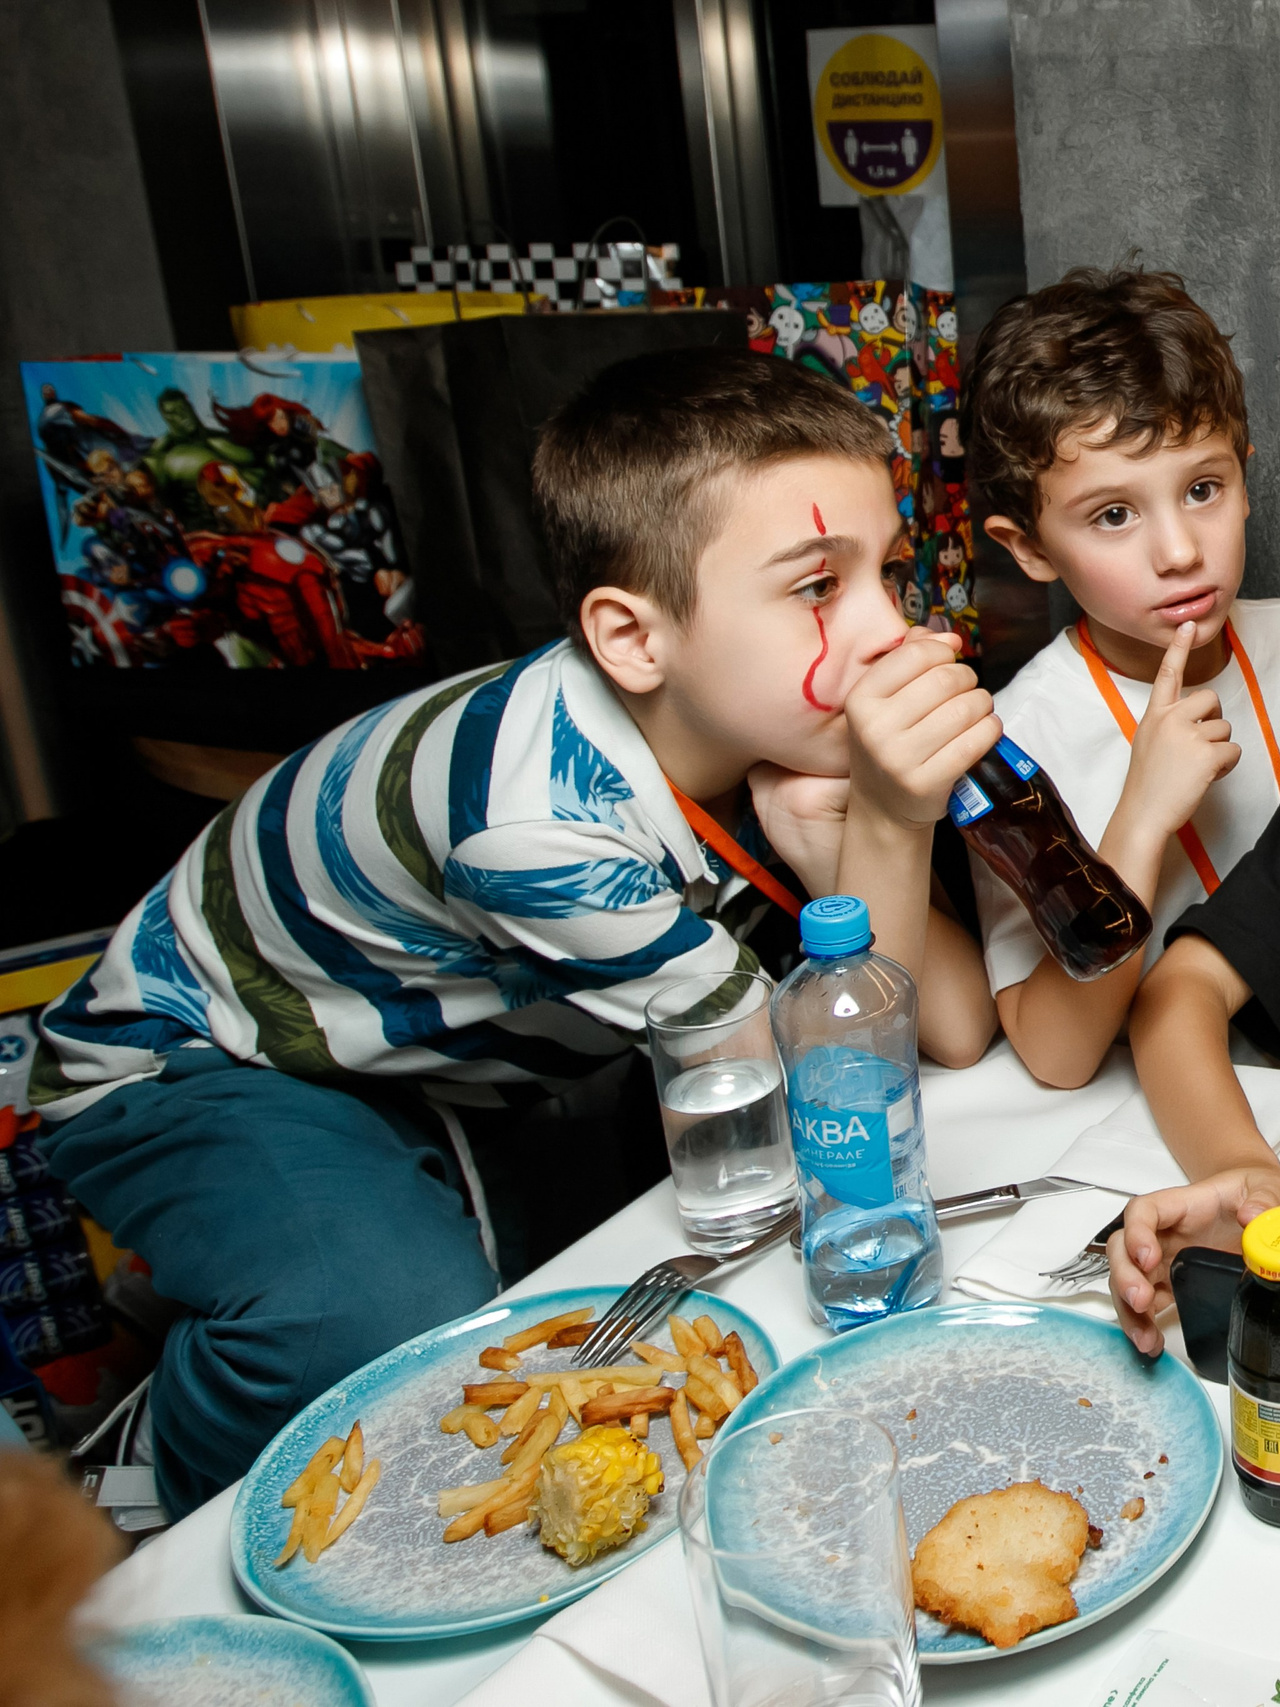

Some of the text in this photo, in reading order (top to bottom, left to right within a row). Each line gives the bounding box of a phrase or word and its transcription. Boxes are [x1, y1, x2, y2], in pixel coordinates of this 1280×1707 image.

[830, 67, 922, 87] СОБЛЮДАЙ
[833, 93, 922, 108] ДИСТАНЦИЮ
[792, 1108, 871, 1148] АКВА
[1264, 1438, 1279, 1454] EAC
